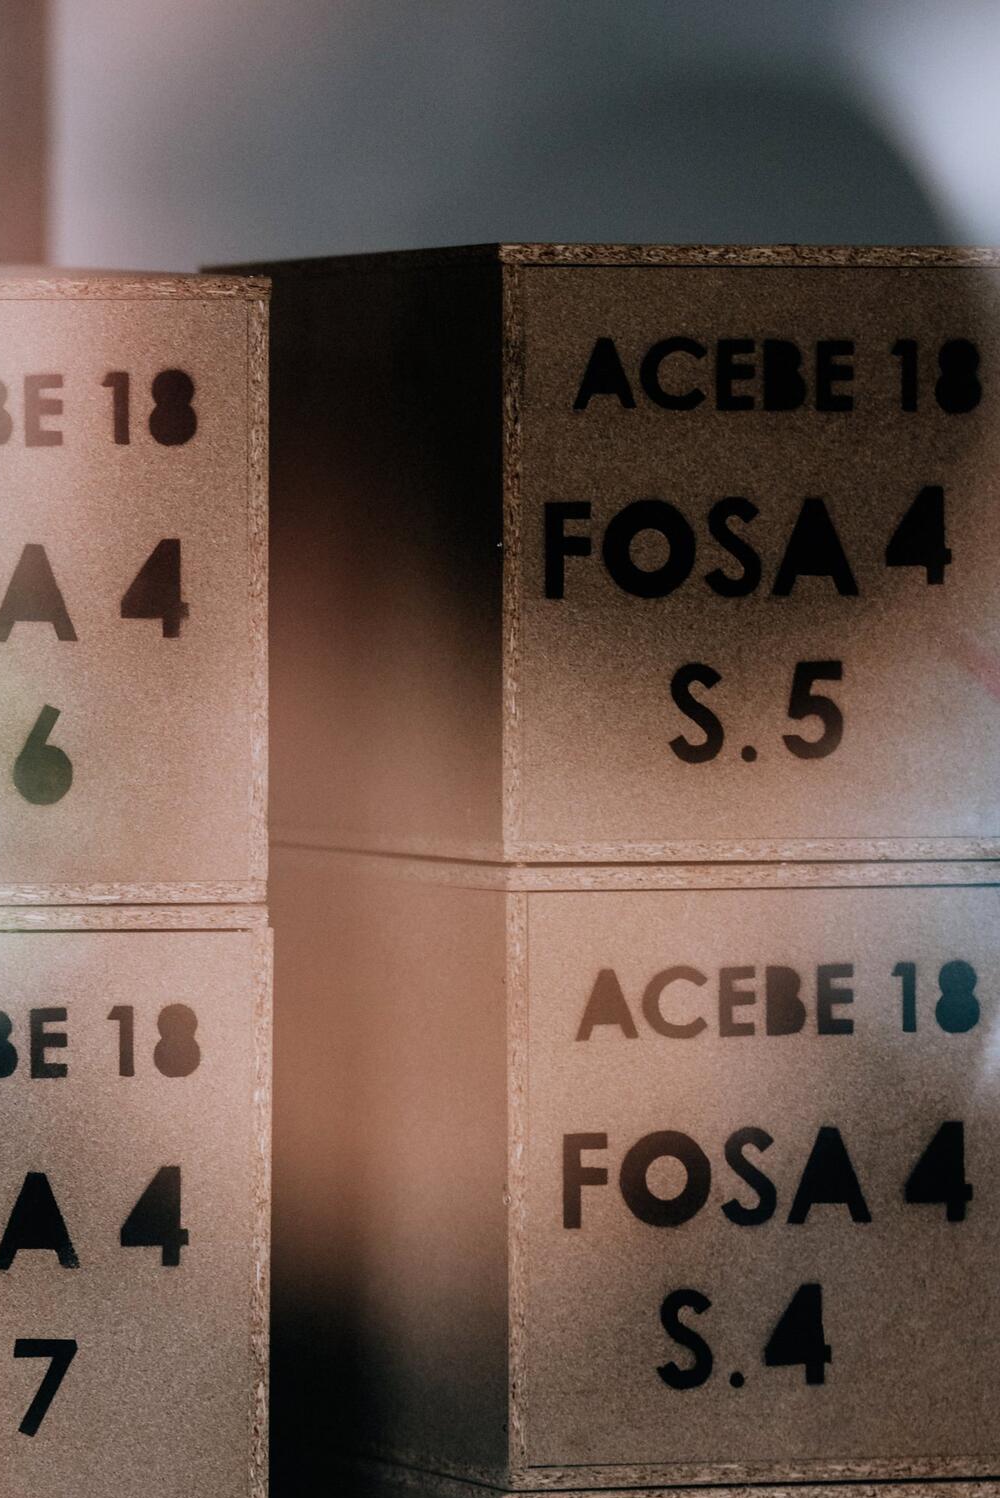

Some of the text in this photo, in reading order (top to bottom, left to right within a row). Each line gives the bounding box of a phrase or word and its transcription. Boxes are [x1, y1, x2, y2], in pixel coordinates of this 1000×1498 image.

[101, 369, 197, 446] 18
[573, 336, 983, 414] ACEBE 18
[544, 486, 952, 599] FOSA 4
[120, 539, 190, 639] 4
[107, 1003, 200, 1078] 18
[576, 960, 981, 1041] ACEBE 18
[120, 1166, 188, 1266] 4
[563, 1121, 973, 1229] FOSA 4
